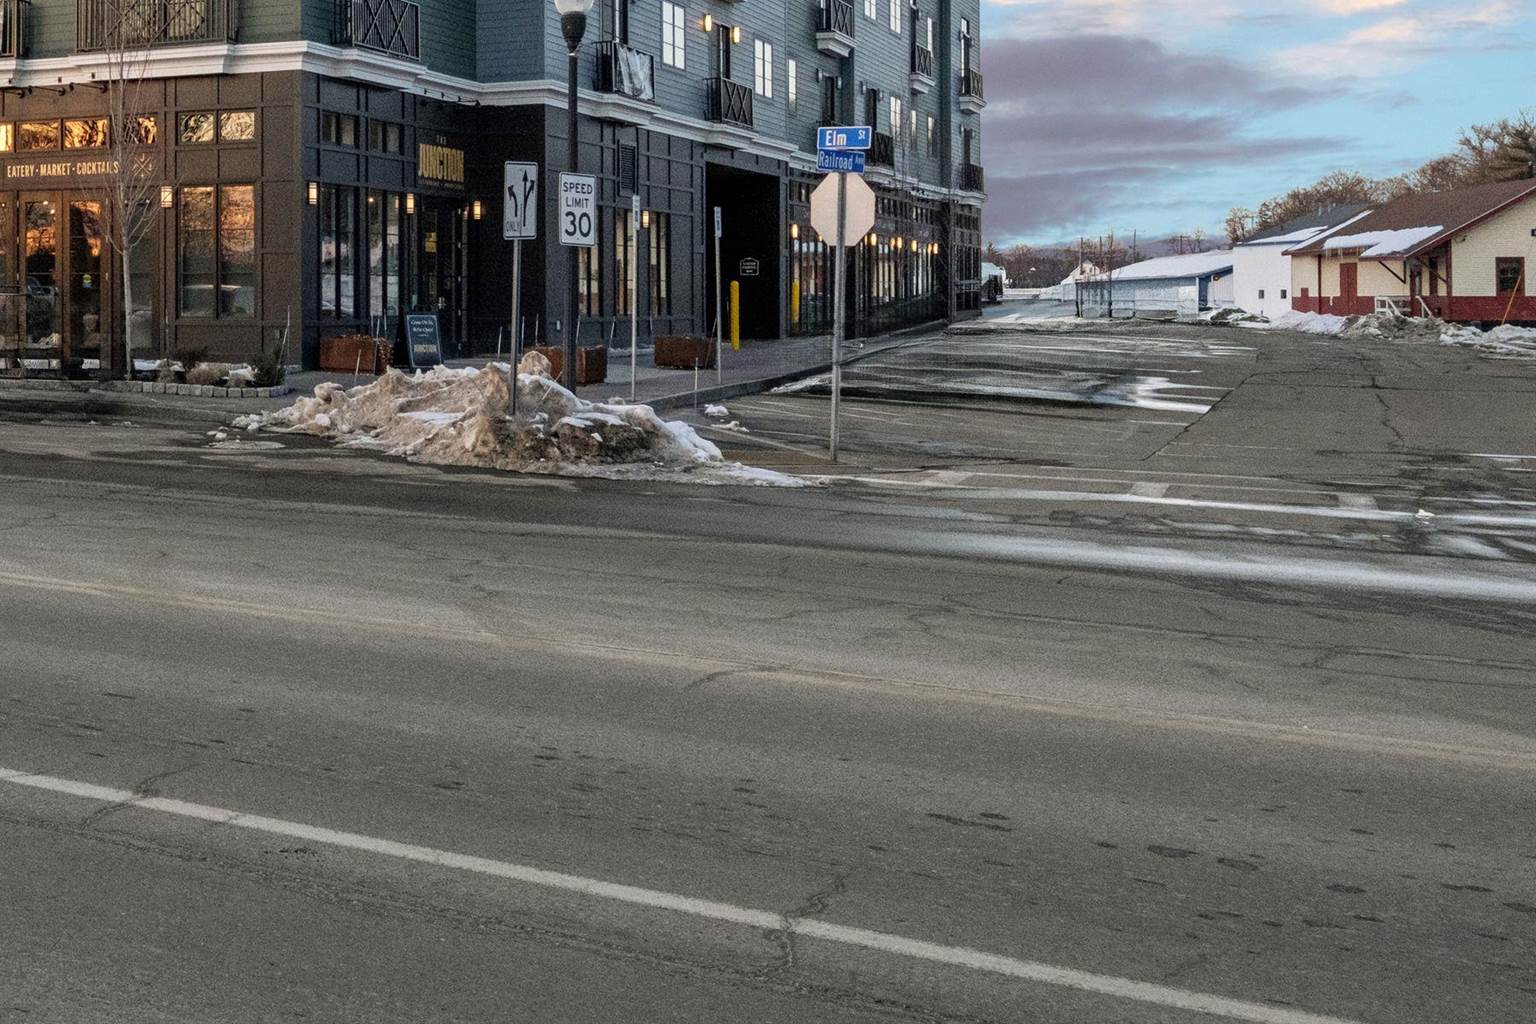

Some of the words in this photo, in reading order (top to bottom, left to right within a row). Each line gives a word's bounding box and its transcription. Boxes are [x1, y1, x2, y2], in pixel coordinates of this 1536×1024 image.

[825, 130, 847, 146] Elm
[858, 129, 866, 140] St
[417, 143, 465, 183] JUNCTION
[818, 151, 854, 170] Railroad
[7, 164, 34, 178] EATERY
[39, 163, 71, 177] MARKET
[76, 161, 120, 175] COCKTAILS
[562, 181, 593, 195] SPEED
[565, 196, 590, 209] LIMIT
[564, 211, 592, 238] 30
